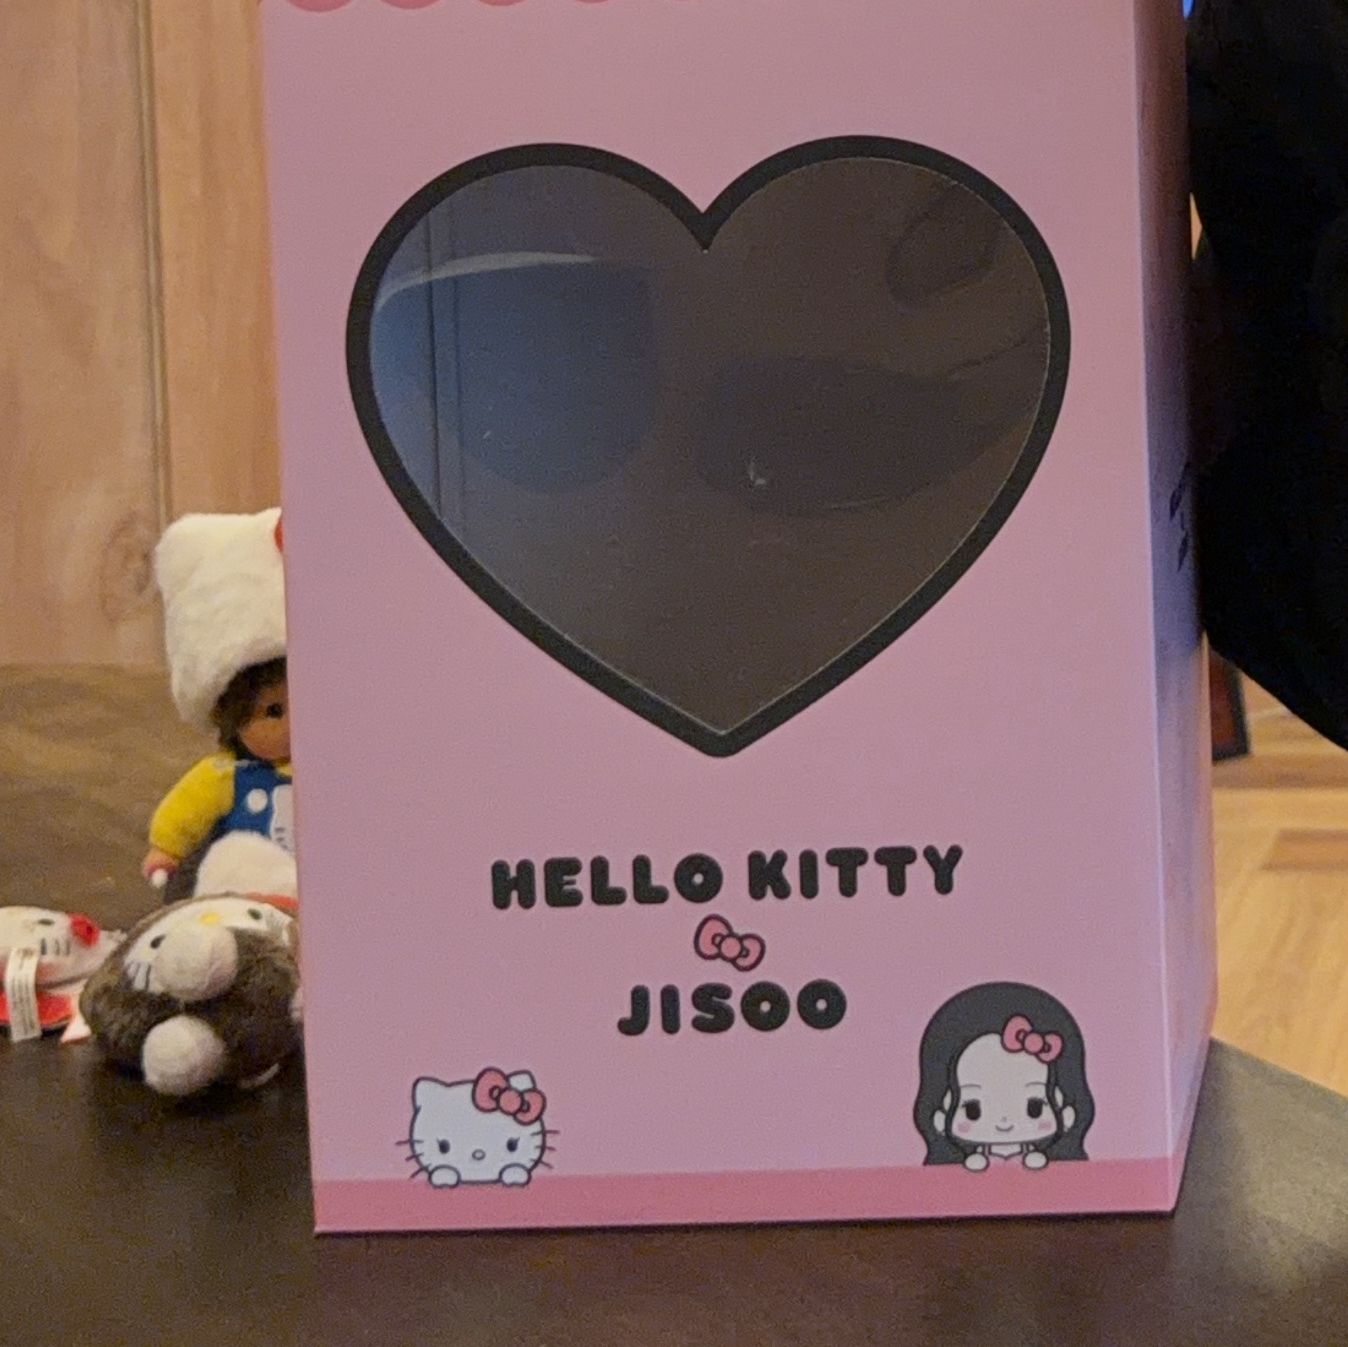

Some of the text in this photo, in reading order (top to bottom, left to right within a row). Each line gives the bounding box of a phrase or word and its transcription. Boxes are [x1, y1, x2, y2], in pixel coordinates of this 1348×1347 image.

[491, 844, 963, 910] HELLO KITTY
[617, 979, 847, 1036] JISOO
